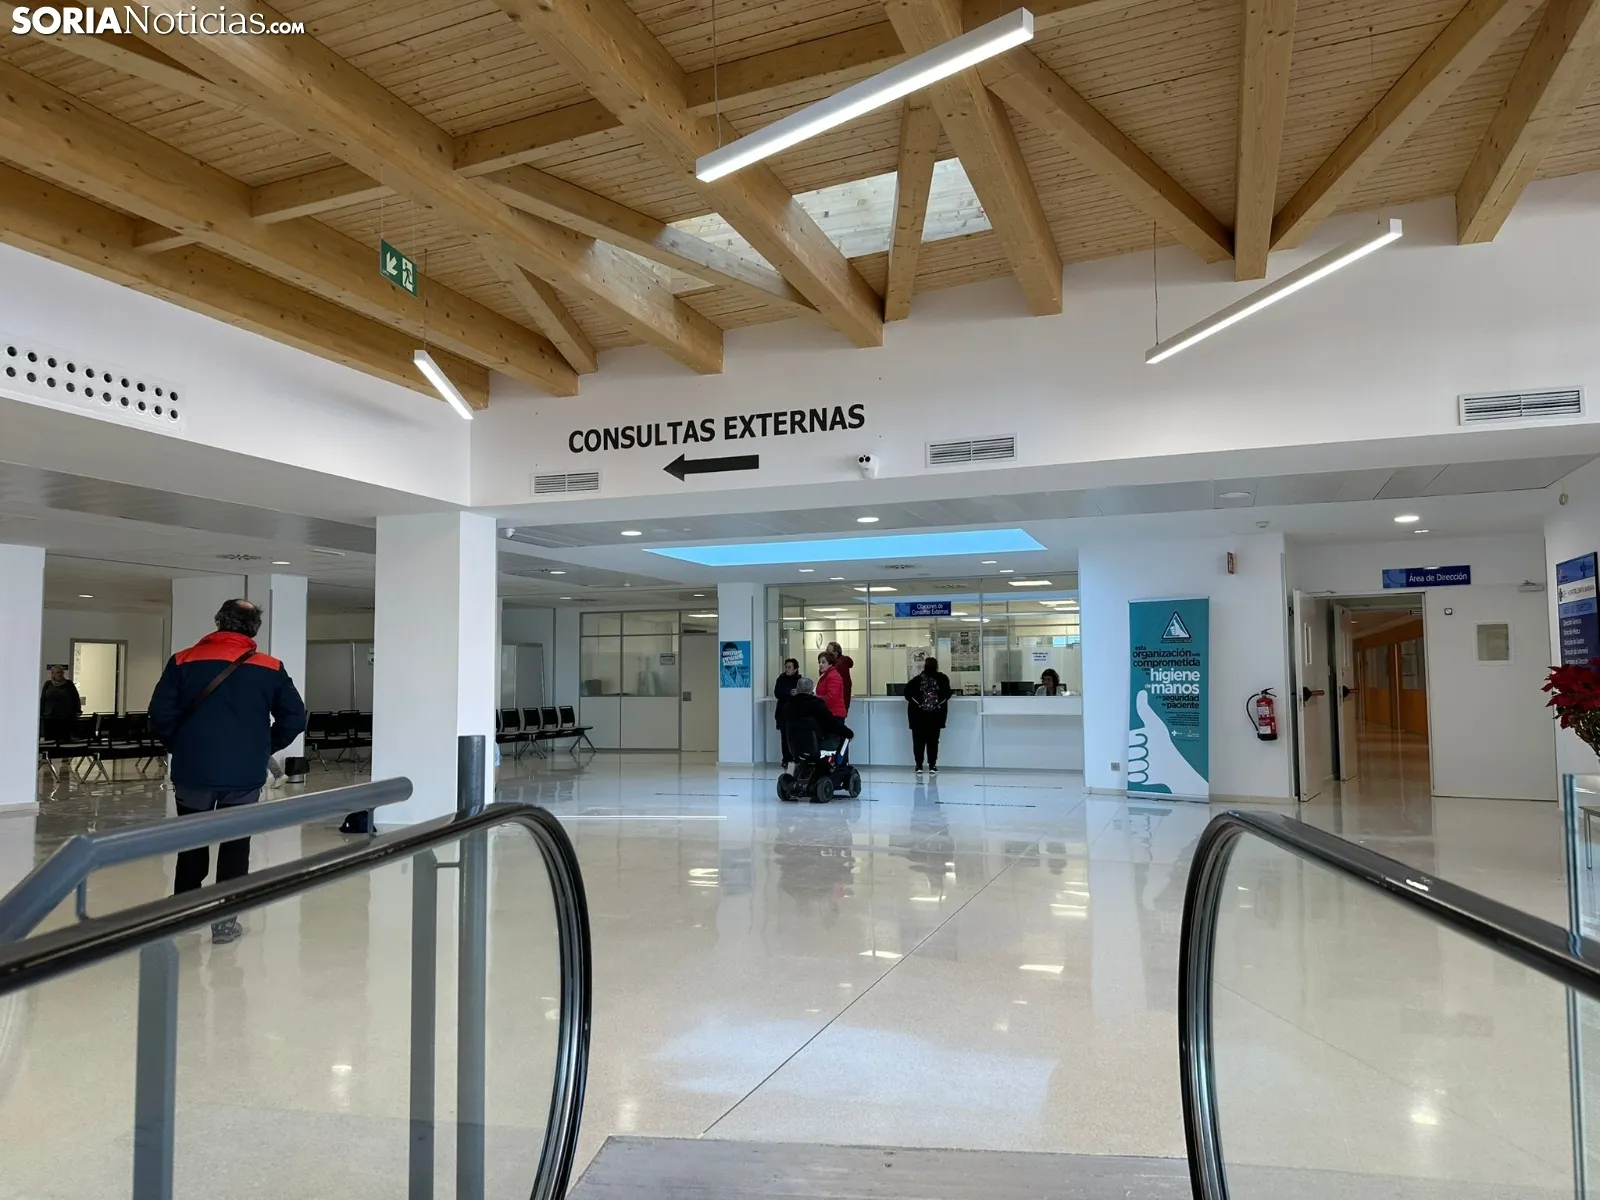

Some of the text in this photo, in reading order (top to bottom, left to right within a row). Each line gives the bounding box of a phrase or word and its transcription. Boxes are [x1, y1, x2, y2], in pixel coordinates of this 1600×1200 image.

[568, 403, 865, 453] CONSULTAS EXTERNAS
[1408, 572, 1468, 582] Área de Dirección
[1132, 648, 1192, 659] organización
[1133, 658, 1200, 668] comprometida
[1150, 668, 1200, 683] higiene
[1151, 683, 1200, 694] manos
[1162, 695, 1200, 703] seguridad
